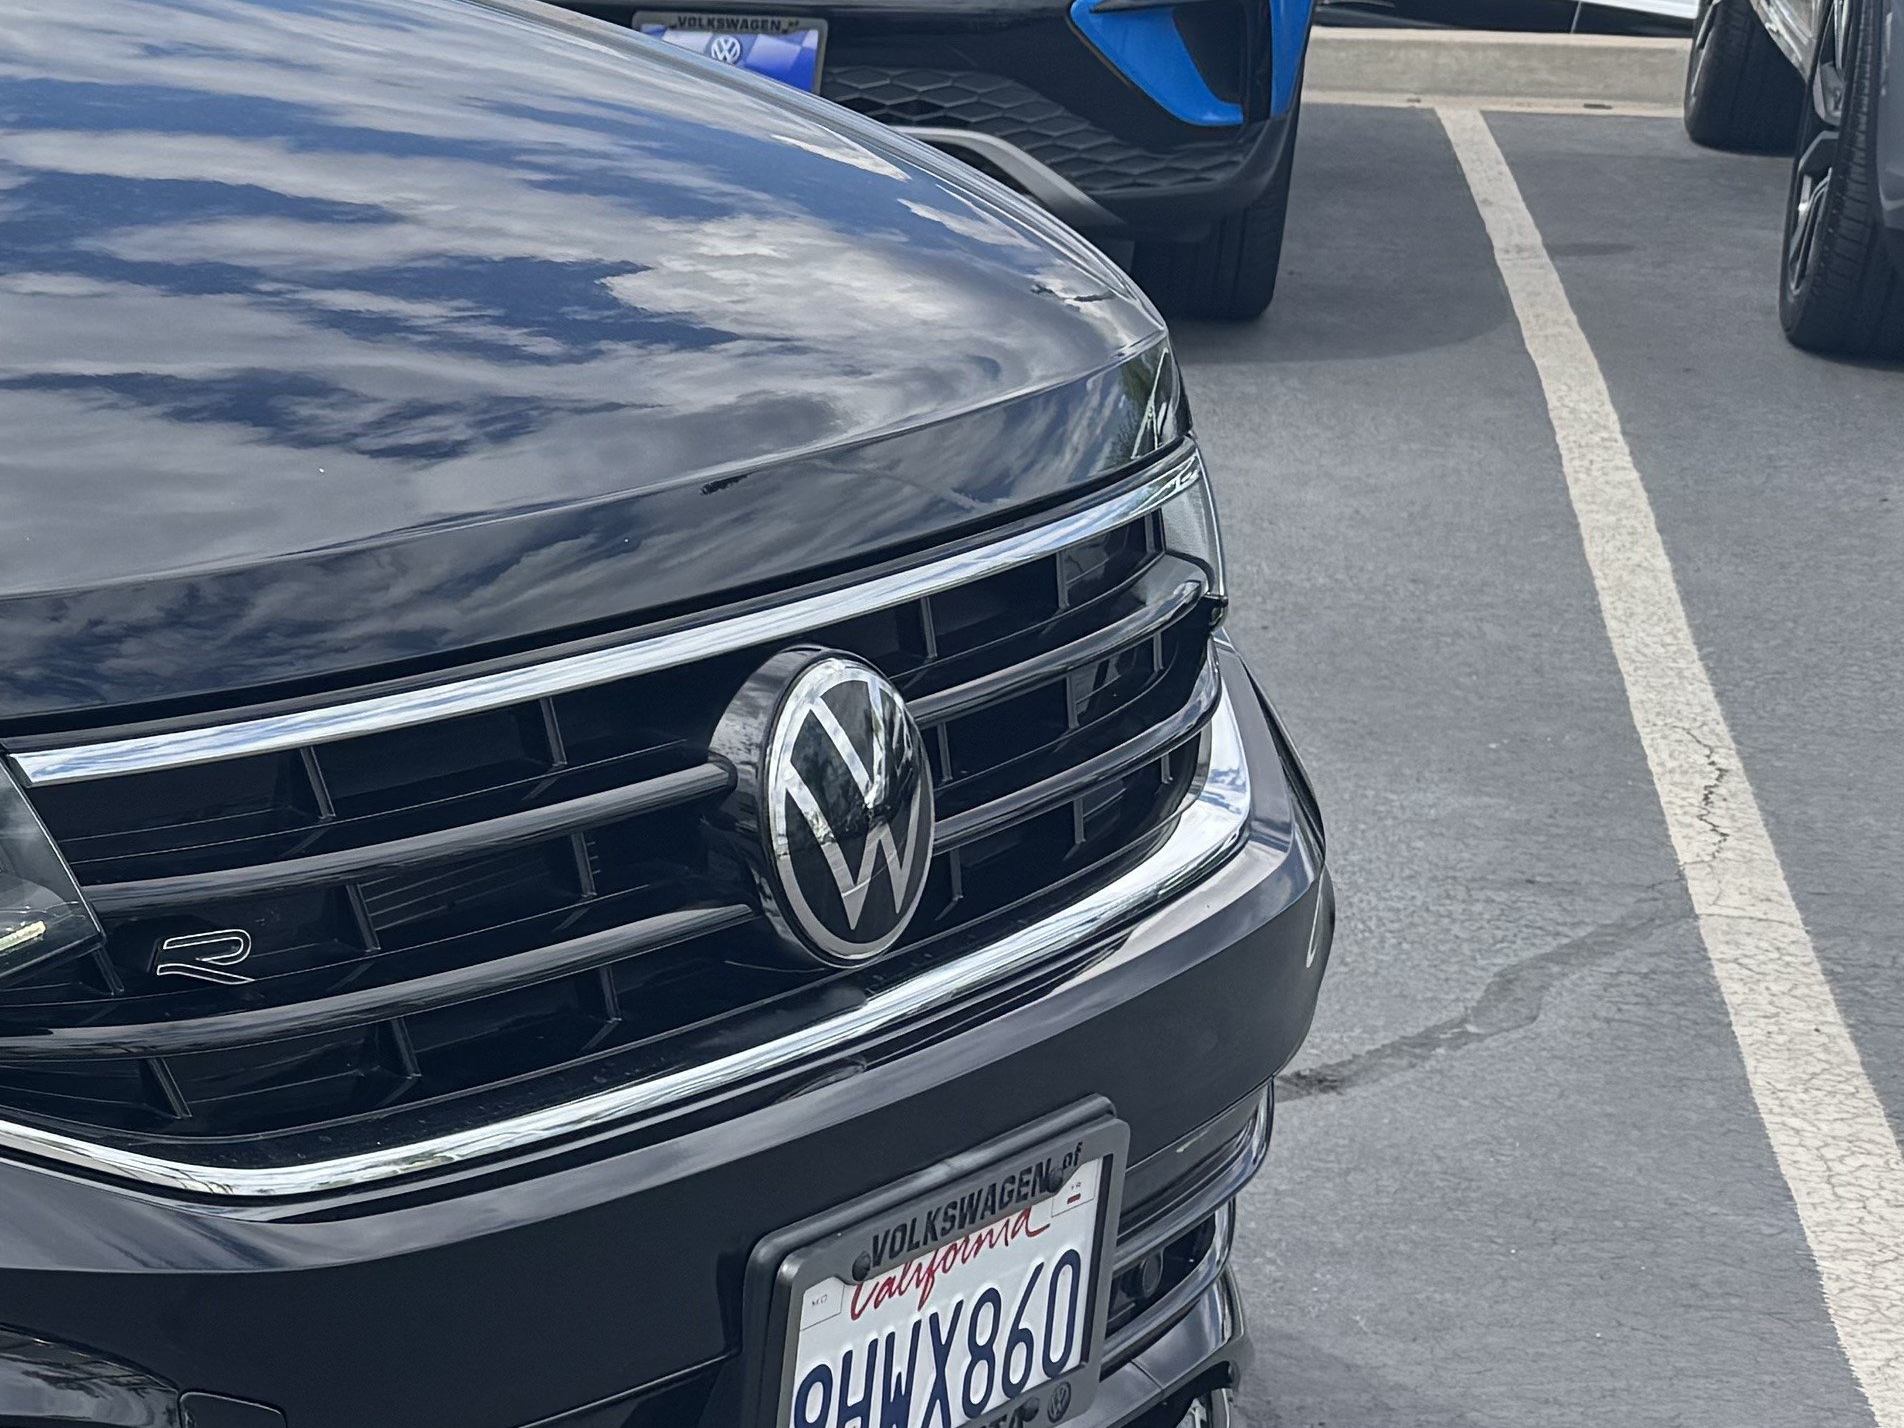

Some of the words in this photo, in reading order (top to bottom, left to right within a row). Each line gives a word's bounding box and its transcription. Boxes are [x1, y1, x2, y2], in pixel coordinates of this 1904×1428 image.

[676, 15, 782, 31] VOLKSWAGEN
[871, 1157, 1053, 1268] VOLKSWAGEN
[1062, 1141, 1083, 1170] of
[850, 1206, 1051, 1322] California
